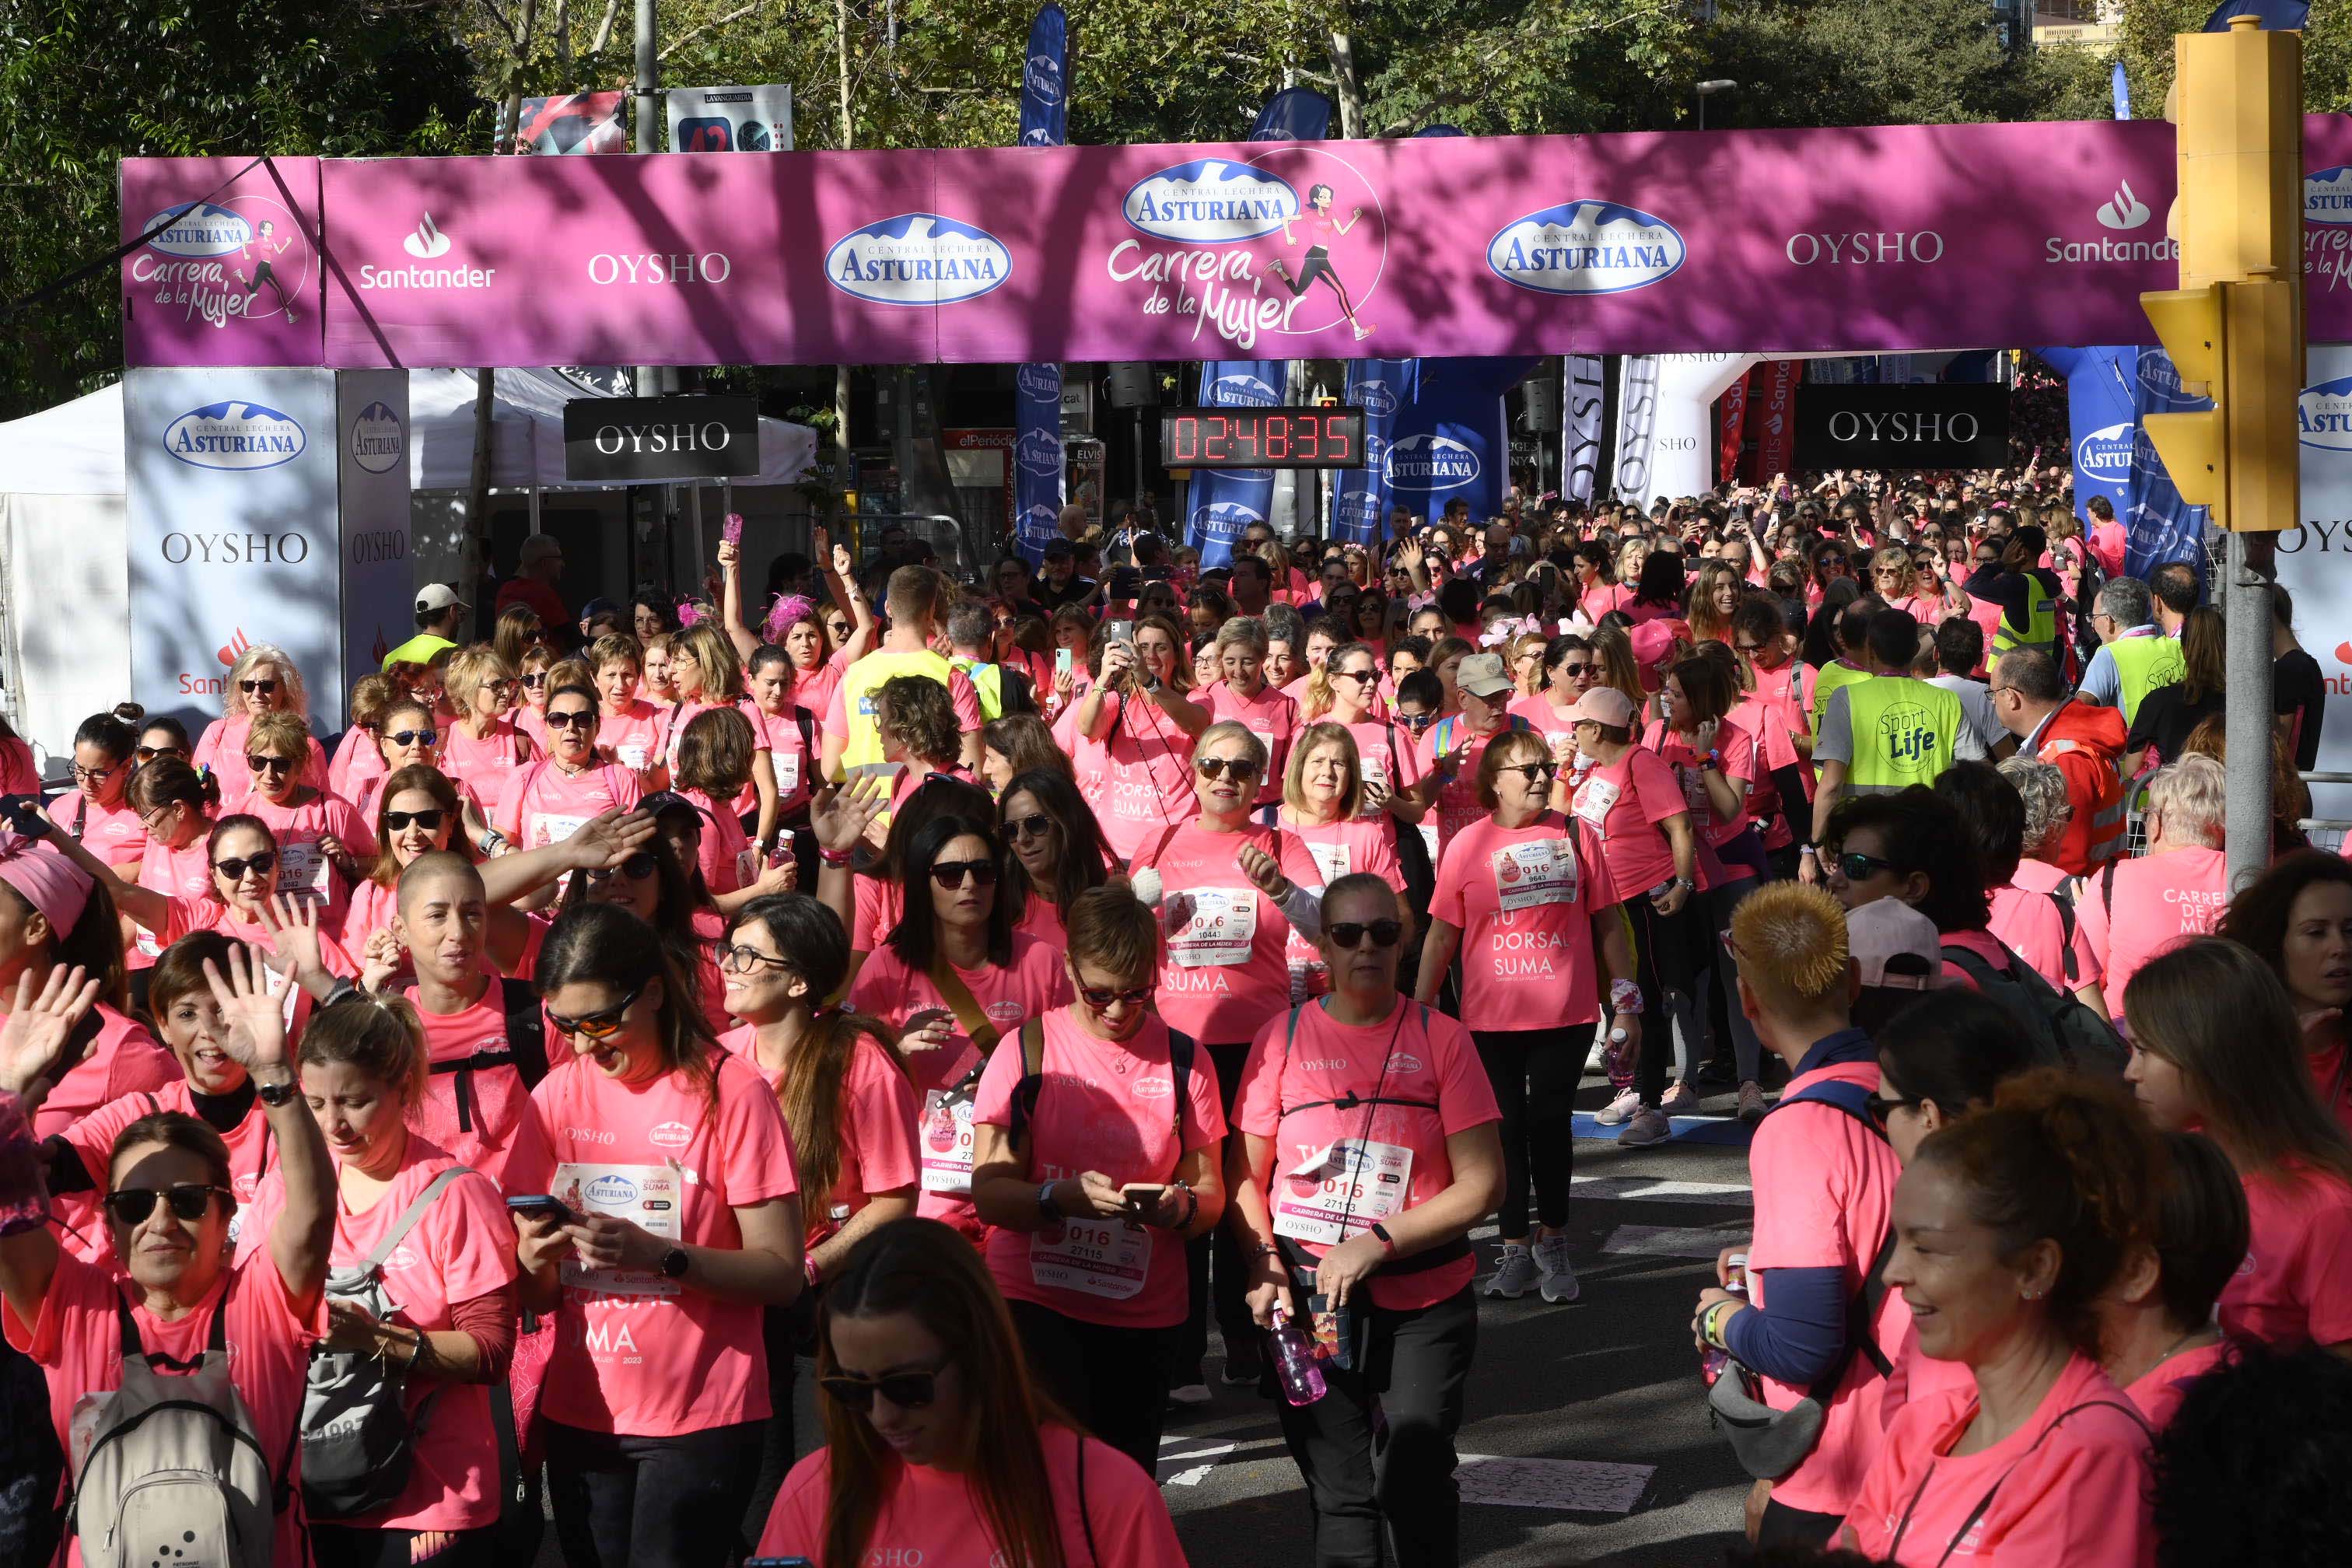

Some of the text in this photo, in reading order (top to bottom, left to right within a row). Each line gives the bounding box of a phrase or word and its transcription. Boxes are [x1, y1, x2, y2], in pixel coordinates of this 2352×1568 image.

[1164, 187, 1282, 197] CENTRAL LECHERA
[2304, 194, 2352, 210] STUR
[1136, 191, 1285, 222] ASTURIANA
[1532, 231, 1664, 243] CENTRAL LECHERA
[867, 244, 991, 254] CENTRAL LECHERA
[1503, 236, 1670, 271] ASTURIANA
[1786, 230, 1944, 265] OYSHO
[2046, 236, 2179, 263] Santande
[132, 254, 222, 283] Carrera
[588, 252, 731, 285] OYSHO
[838, 248, 997, 282] ASTURIANA
[1107, 239, 1254, 283] Carrera
[360, 264, 495, 289] Santander
[155, 277, 258, 328] de la Mujer
[1143, 277, 1307, 350] de la Mujer
[1213, 389, 1278, 408] ASTURIAN
[1570, 355, 1602, 502] OYSH
[1619, 355, 1657, 494] OYSH
[1829, 411, 1979, 443] OYSHO
[174, 426, 296, 453] ASTURIANA
[355, 425, 401, 457] ASTURIANA
[595, 421, 730, 455] OYSHO
[1174, 416, 1349, 460] 02:48:35
[1076, 449, 1101, 460] ELVIS
[1384, 457, 1473, 479] ASTURIANA
[161, 532, 309, 564] OYSHO
[352, 529, 404, 565] OYSHO
[1880, 708, 1927, 735] Sport
[1889, 726, 1935, 761] Life
[635, 768, 649, 777] 16
[1113, 799, 1153, 817] SUMA
[1458, 807, 1483, 816] DOR
[1522, 863, 1550, 874] 016
[1528, 874, 1547, 883] 9643
[1507, 895, 1533, 905] OYSHO
[1489, 908, 1515, 926] TU
[2182, 903, 2207, 919] DE
[1493, 932, 1570, 951] DORSAL
[1494, 955, 1553, 975] SUMA
[1167, 971, 1230, 992] SUMA
[1300, 1058, 1347, 1072] OYSHO
[564, 1126, 615, 1146] OYSHO
[652, 1132, 691, 1142] ASTURIANA
[931, 1161, 962, 1171] CARRERA
[1380, 1159, 1402, 1167] SUMA
[642, 1183, 670, 1192] SUMA
[926, 1174, 961, 1185] OYSHO
[1324, 1178, 1364, 1199] 016
[588, 1184, 634, 1199] ASTURIANA
[1291, 1206, 1324, 1218] CARRERA
[1325, 1213, 1335, 1221] DE
[1346, 1216, 1371, 1227] MUJER
[1069, 1226, 1110, 1245] 016
[1285, 1220, 1322, 1235] OYSHO
[1070, 1245, 1103, 1259] 27115
[1097, 1279, 1134, 1293] Santander
[622, 1356, 642, 1364] 2023
